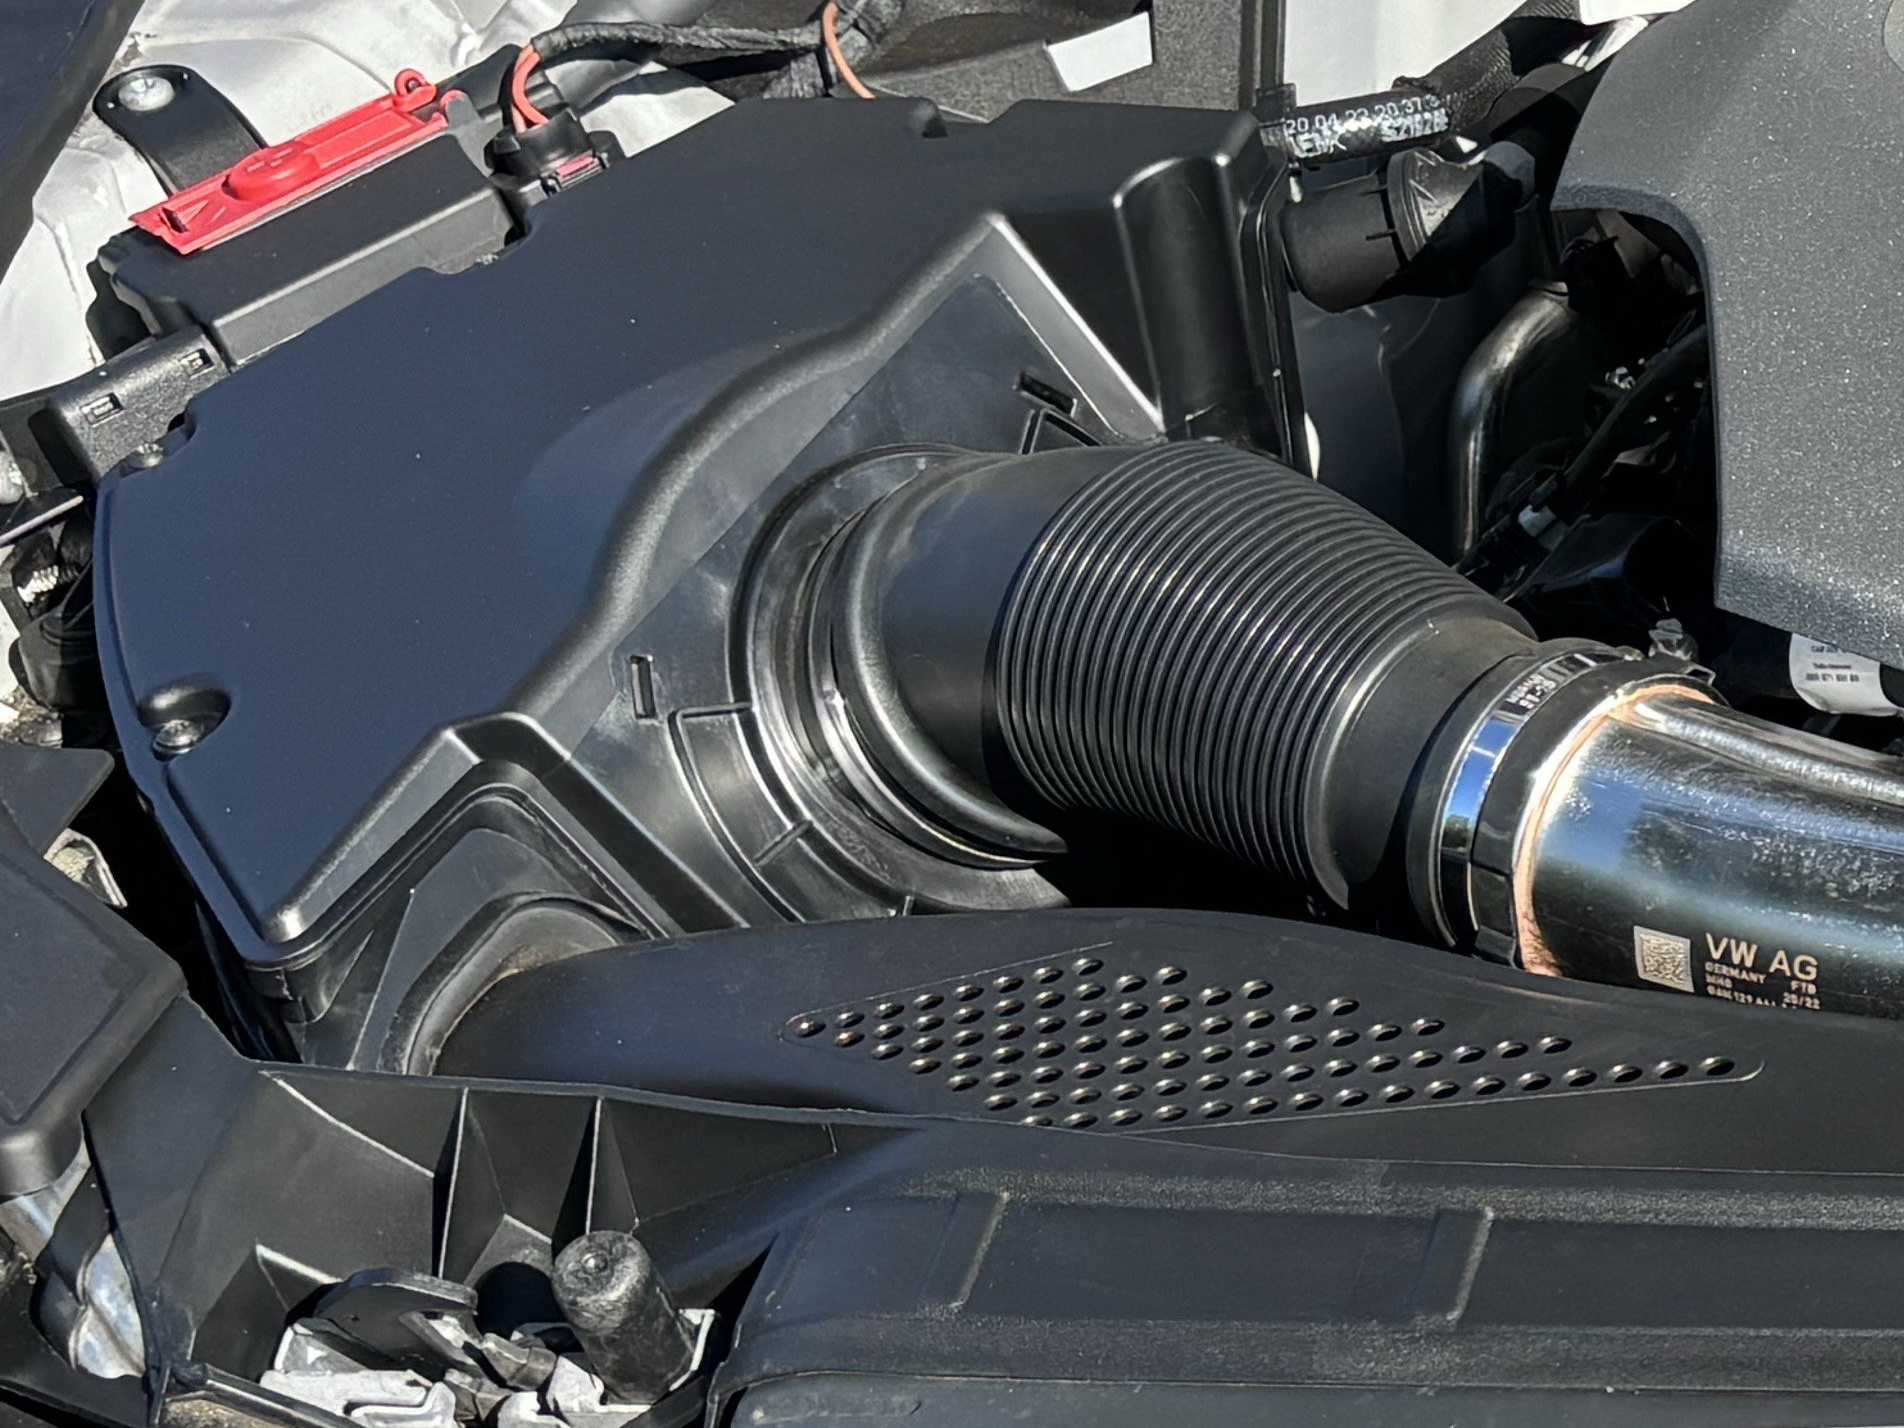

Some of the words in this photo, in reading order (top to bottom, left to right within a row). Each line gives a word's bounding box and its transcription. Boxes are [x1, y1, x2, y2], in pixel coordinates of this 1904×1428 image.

[1705, 961, 1767, 984] GERMANY
[1706, 932, 1758, 968] VW
[1769, 949, 1818, 981] AG
